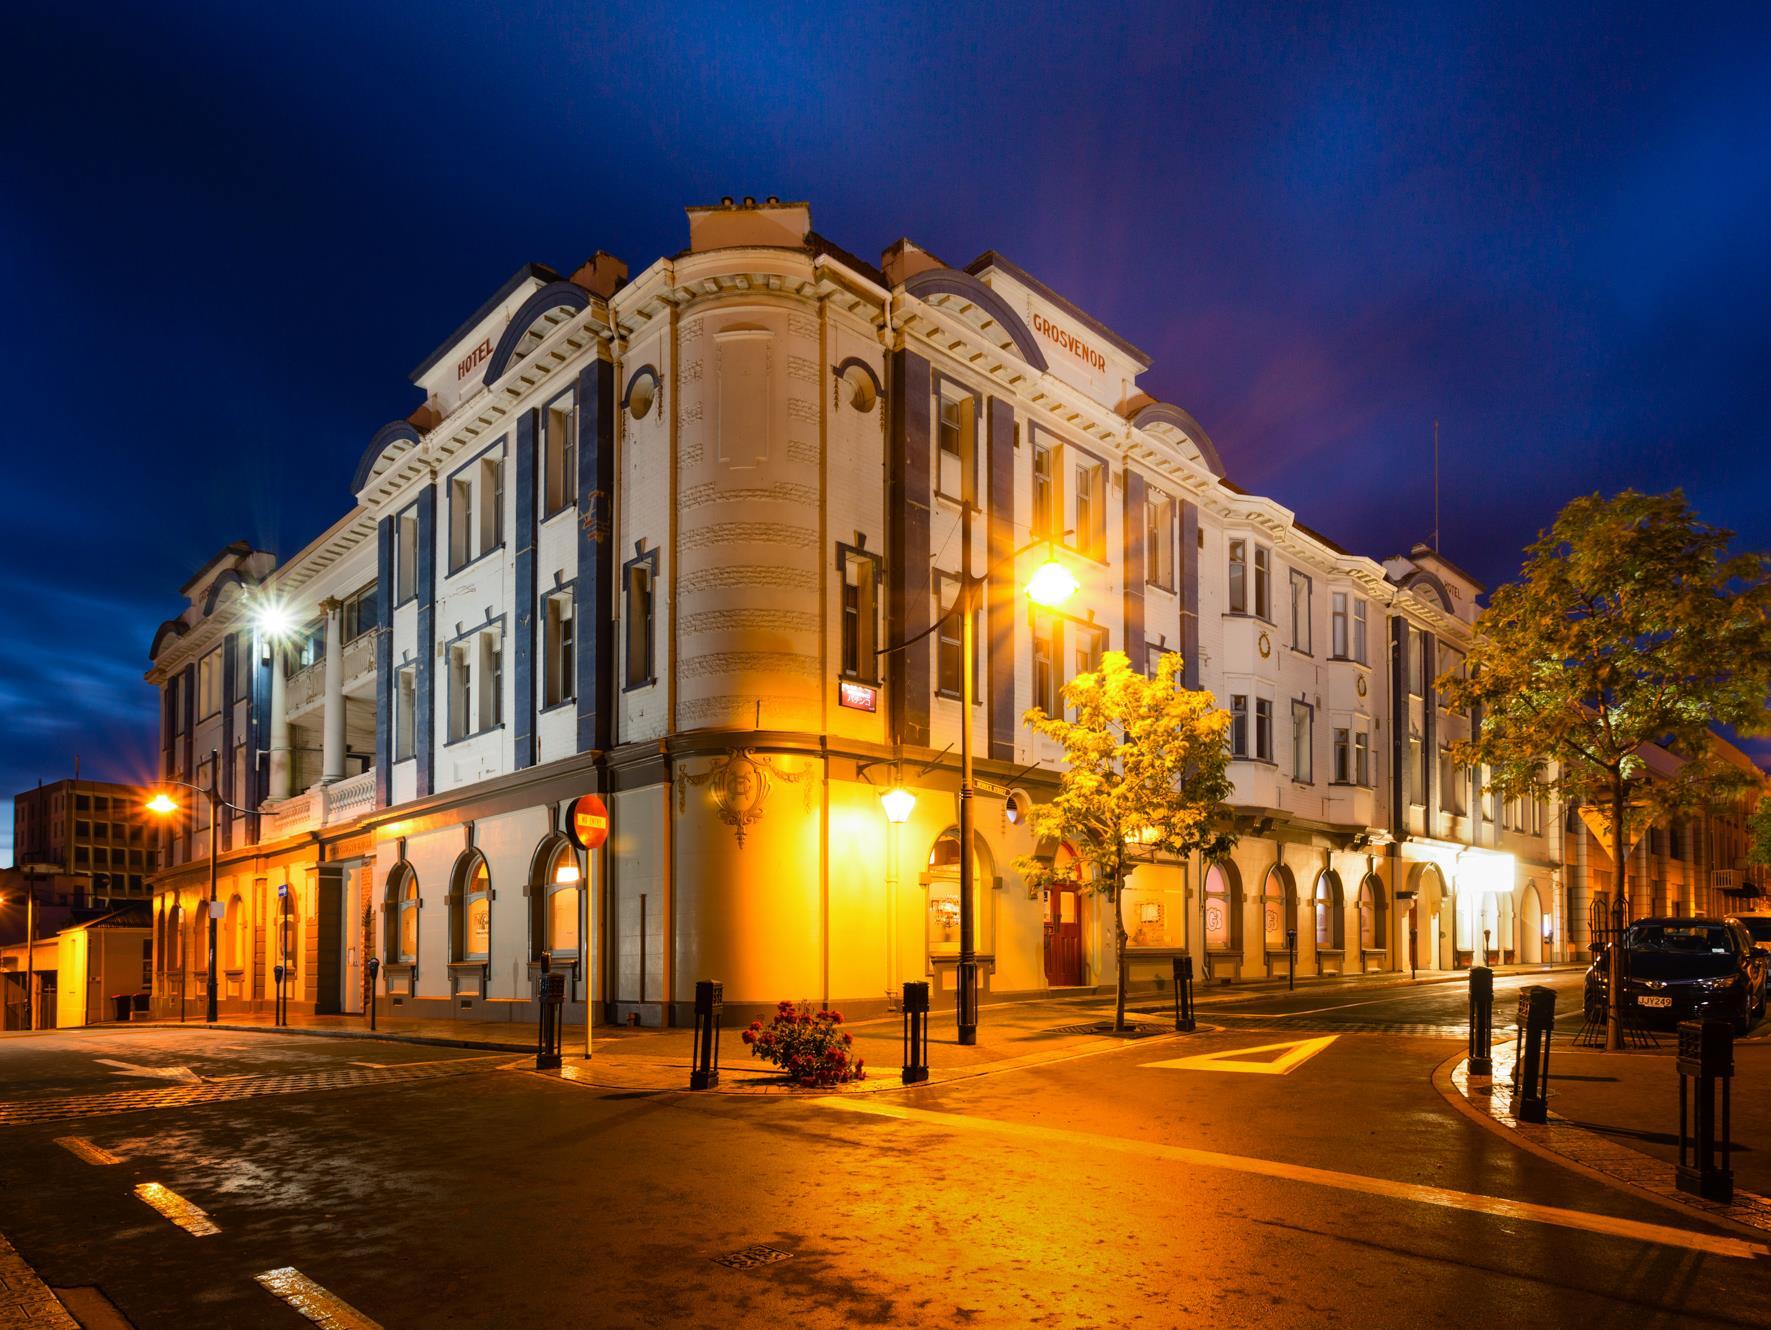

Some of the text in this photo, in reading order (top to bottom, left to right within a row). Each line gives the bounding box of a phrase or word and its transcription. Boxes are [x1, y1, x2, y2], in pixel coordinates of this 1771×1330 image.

[458, 337, 493, 381] HOTEL
[1033, 313, 1105, 373] GROSVENOR
[1639, 997, 1671, 1006] JJY249
